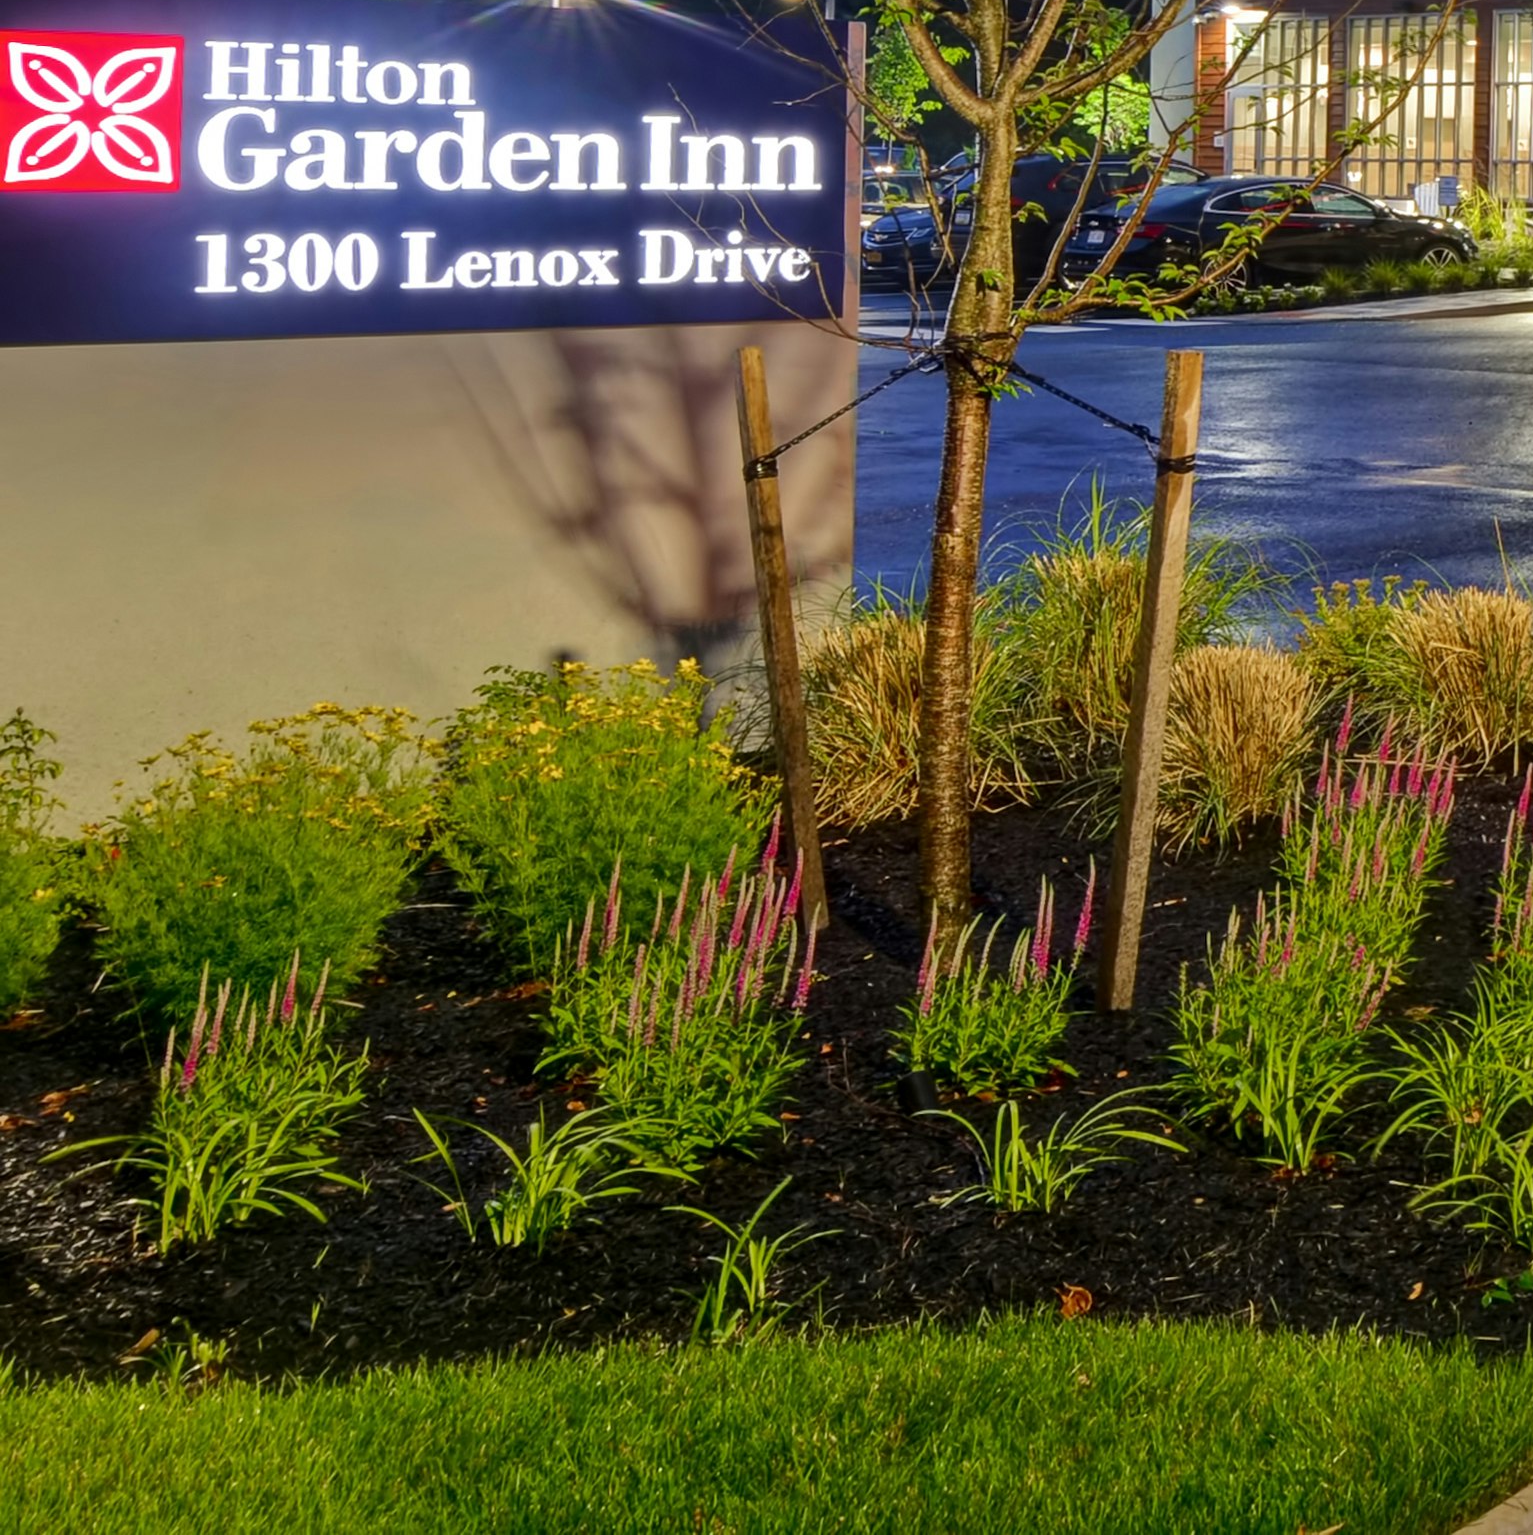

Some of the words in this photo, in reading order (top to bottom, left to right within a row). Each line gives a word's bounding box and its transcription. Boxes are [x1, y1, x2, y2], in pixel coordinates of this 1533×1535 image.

[203, 40, 476, 106] Hilton
[197, 105, 627, 192] Garden
[640, 115, 823, 192] Inn
[194, 232, 380, 294] 1300
[399, 231, 620, 289] Lenox
[637, 229, 811, 285] Drive
